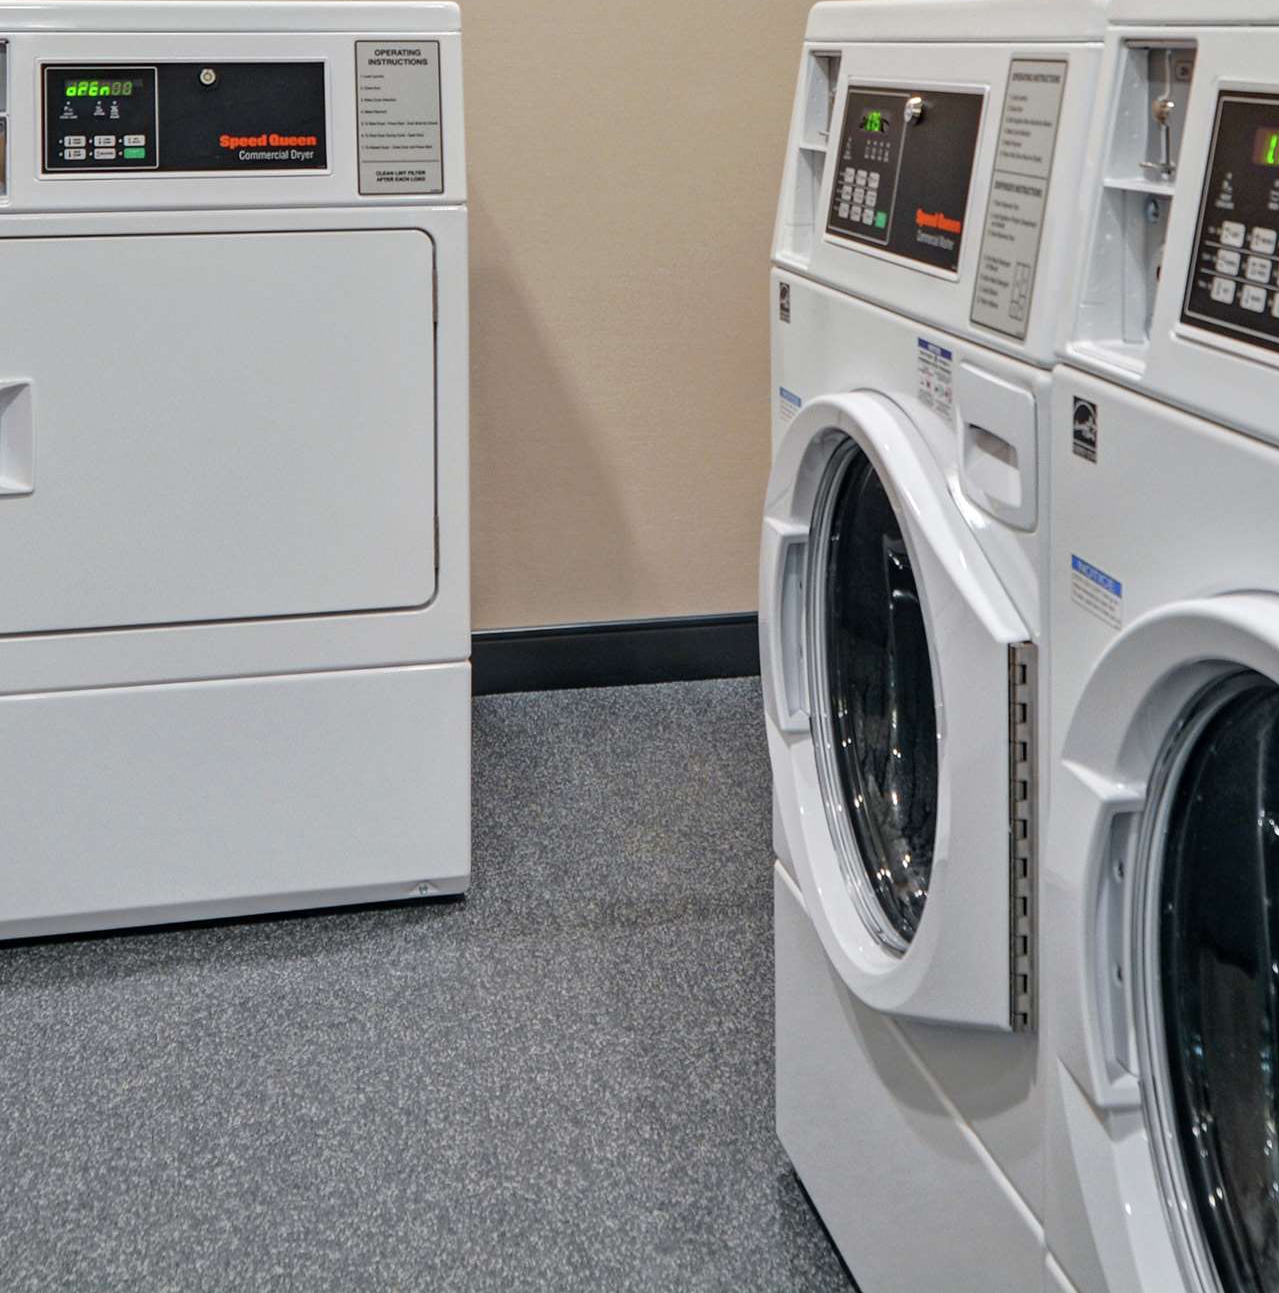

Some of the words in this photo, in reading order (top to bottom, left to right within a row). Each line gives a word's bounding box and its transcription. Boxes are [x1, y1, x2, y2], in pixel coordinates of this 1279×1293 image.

[374, 49, 421, 57] OPERATING
[368, 58, 428, 66] INSTRUCTIONS
[219, 134, 267, 149] Speed
[268, 133, 317, 147] Queen
[239, 149, 289, 161] Commercial
[290, 149, 314, 161] Dryer
